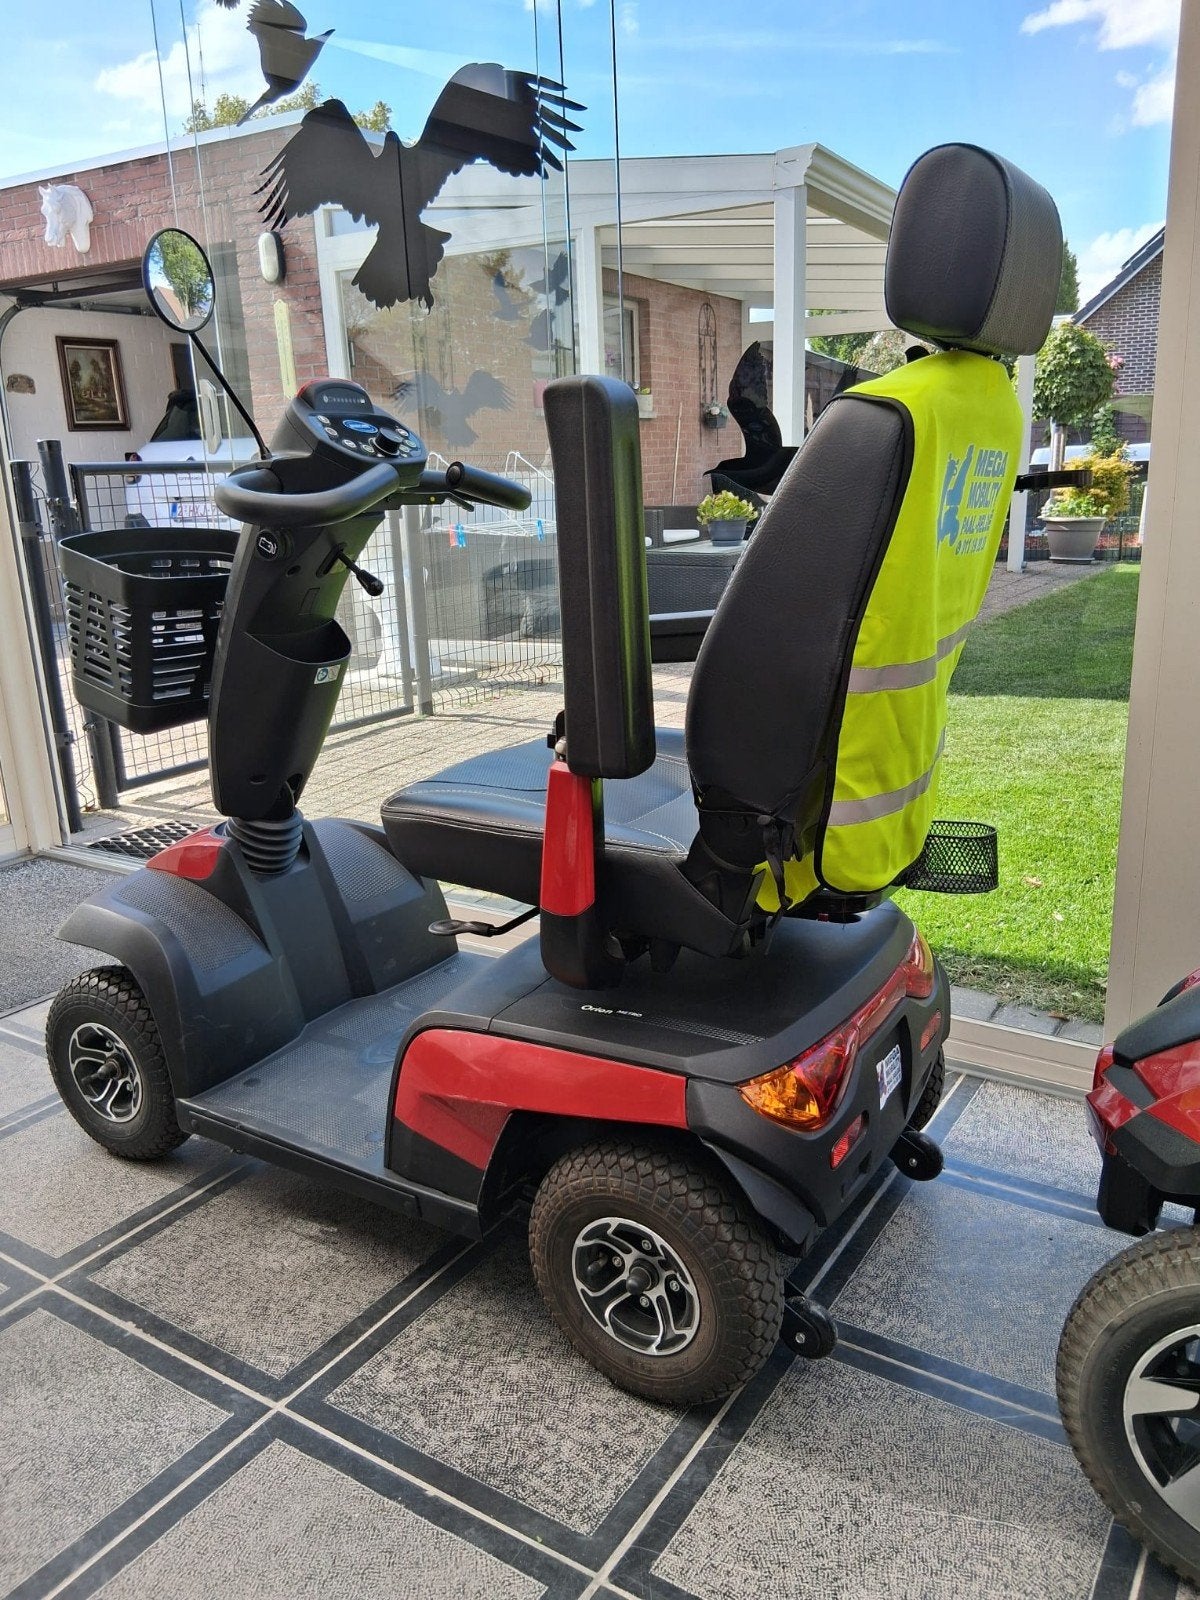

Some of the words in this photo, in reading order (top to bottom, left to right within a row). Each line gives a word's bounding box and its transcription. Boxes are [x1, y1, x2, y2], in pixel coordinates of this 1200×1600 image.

[975, 449, 1008, 477] MEGA
[966, 482, 1002, 509] MOBILITY
[581, 1005, 613, 1014] Orion
